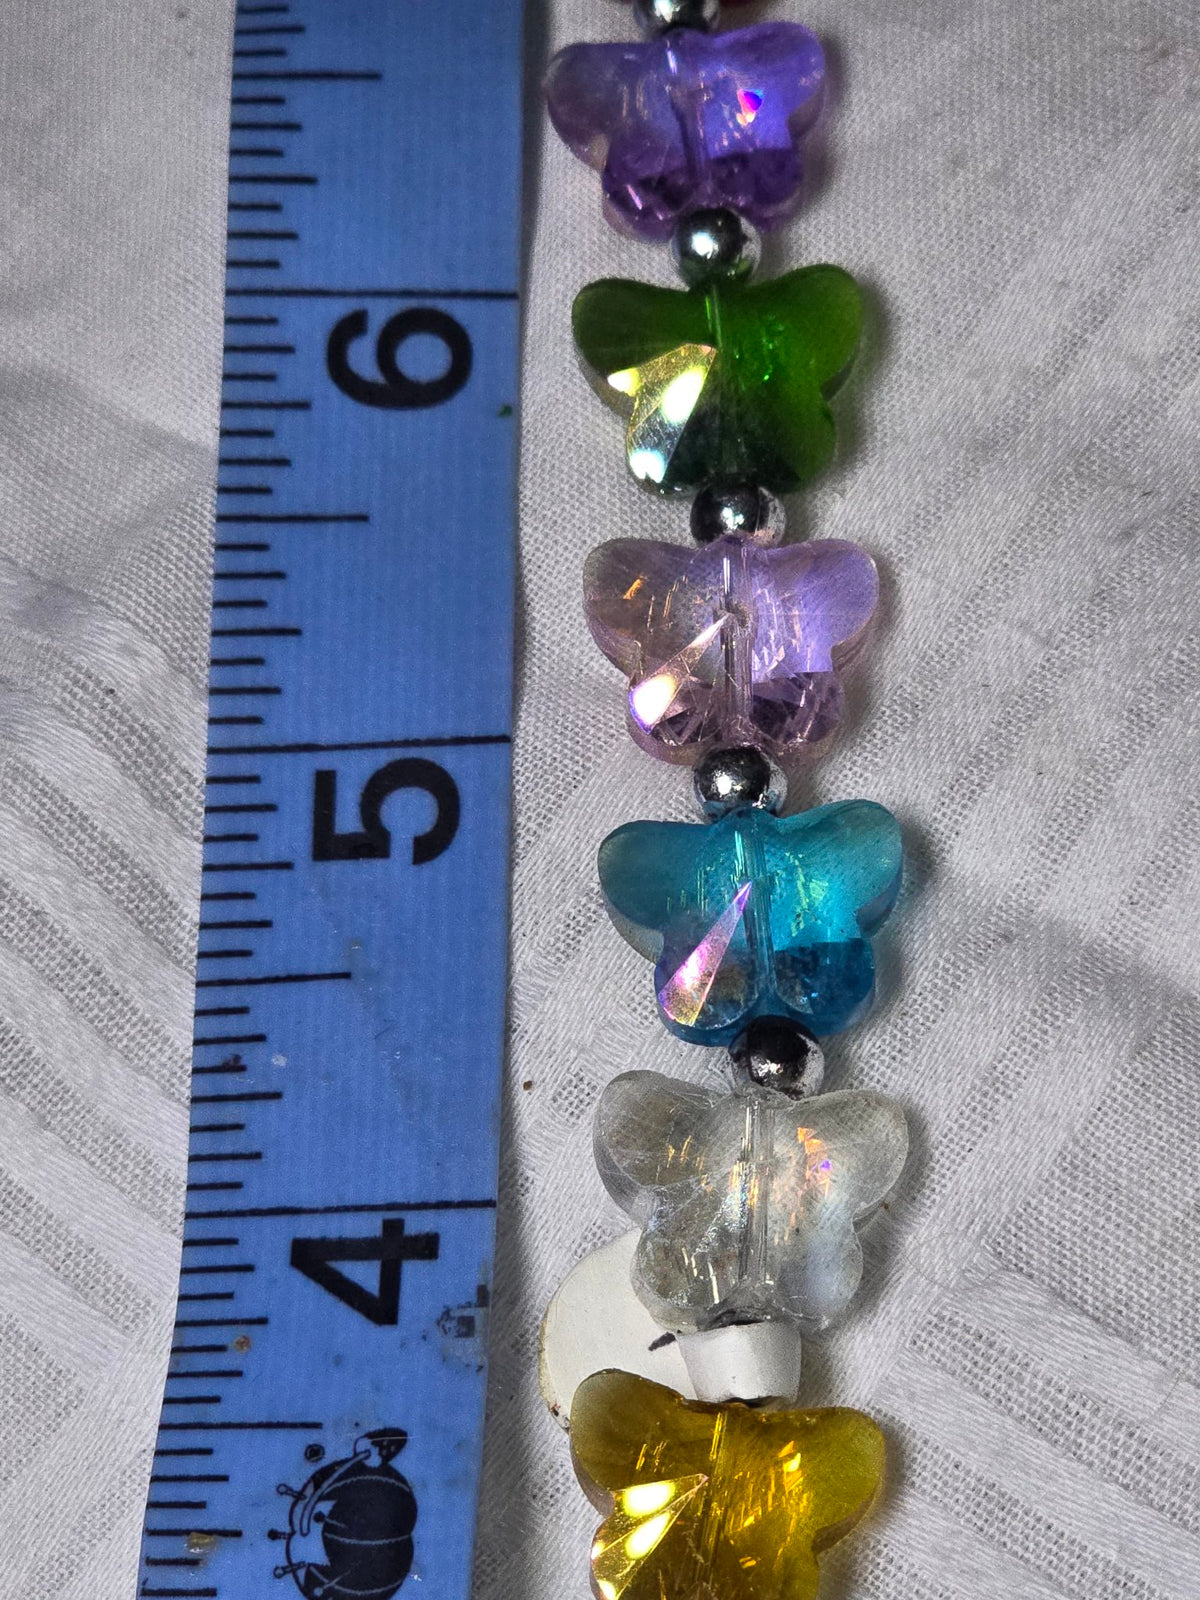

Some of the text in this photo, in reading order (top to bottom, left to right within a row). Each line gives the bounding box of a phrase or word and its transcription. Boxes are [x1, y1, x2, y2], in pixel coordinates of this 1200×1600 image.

[325, 306, 474, 411] 6
[311, 757, 461, 866] 5
[289, 1218, 440, 1327] 4
